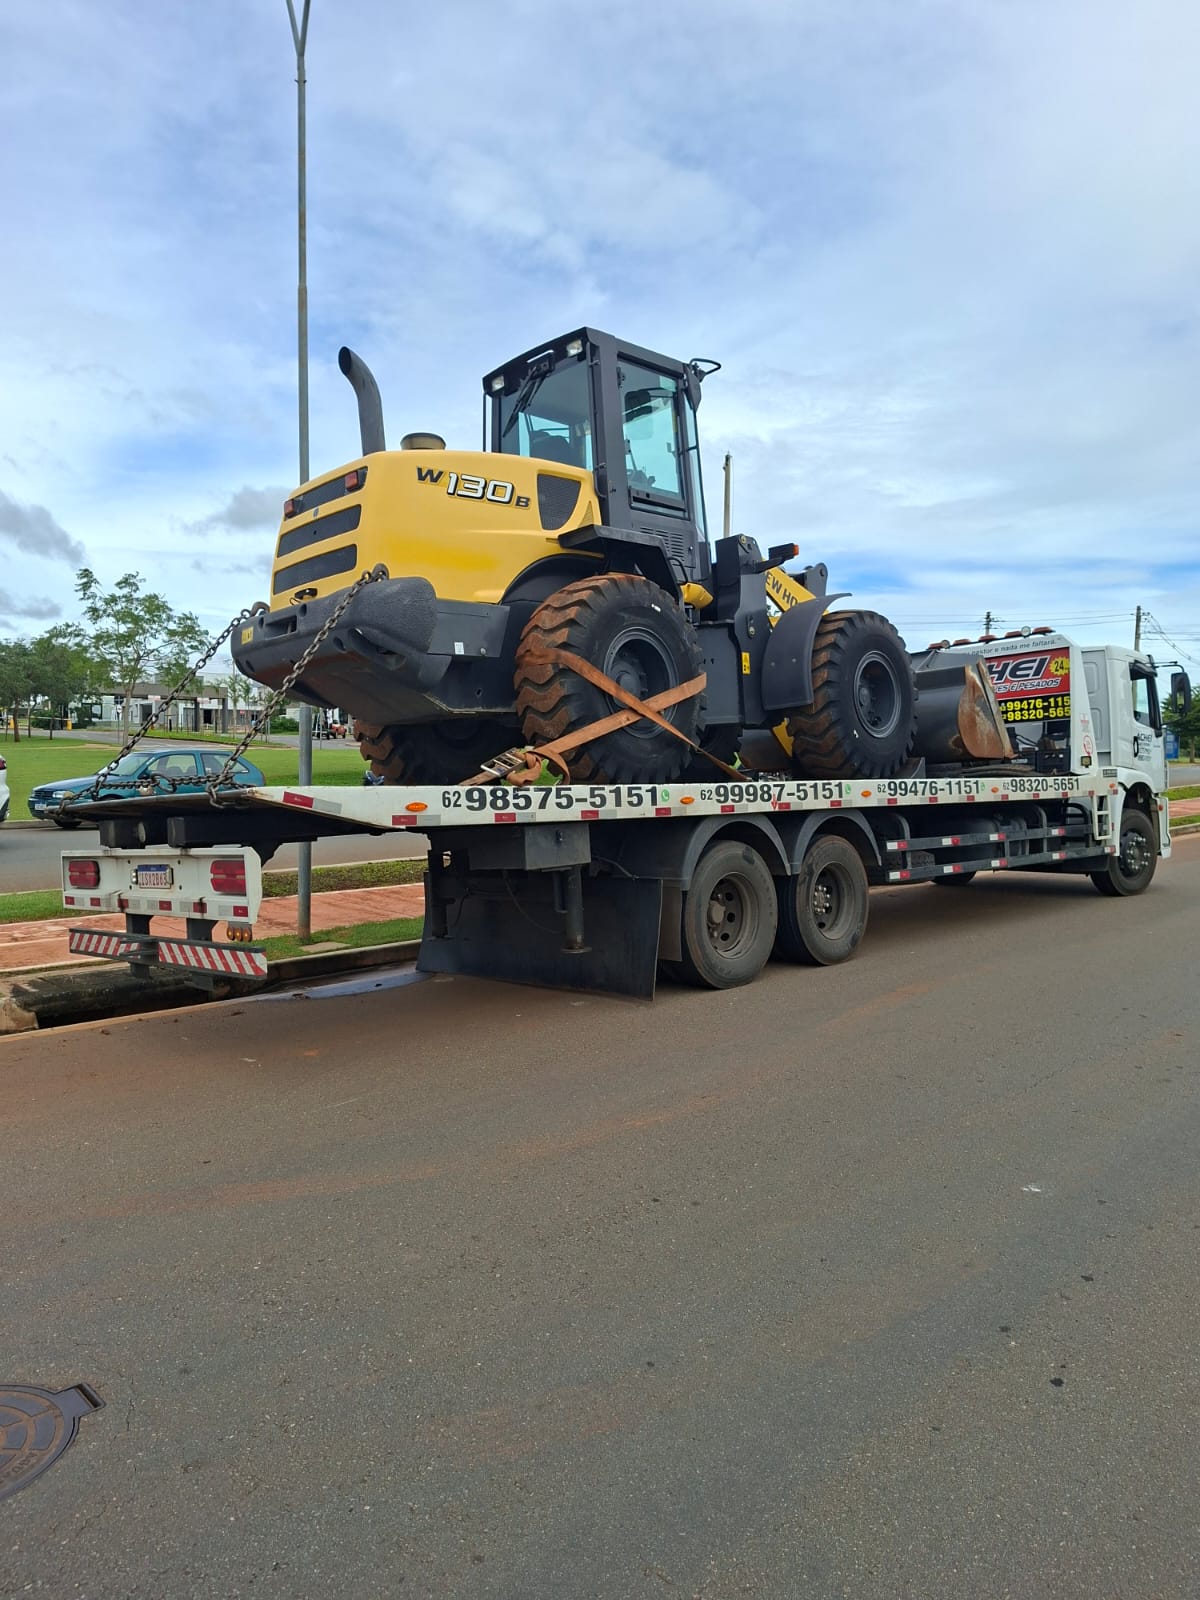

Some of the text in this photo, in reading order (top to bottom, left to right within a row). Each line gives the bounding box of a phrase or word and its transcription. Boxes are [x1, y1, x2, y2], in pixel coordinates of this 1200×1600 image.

[1018, 678, 1061, 690] PESADOS
[700, 782, 843, 803] 62 99987-5151
[888, 780, 979, 797] 99476-1151
[1010, 778, 1080, 792] 98320-5651
[442, 786, 658, 812] 62 98575-5151
